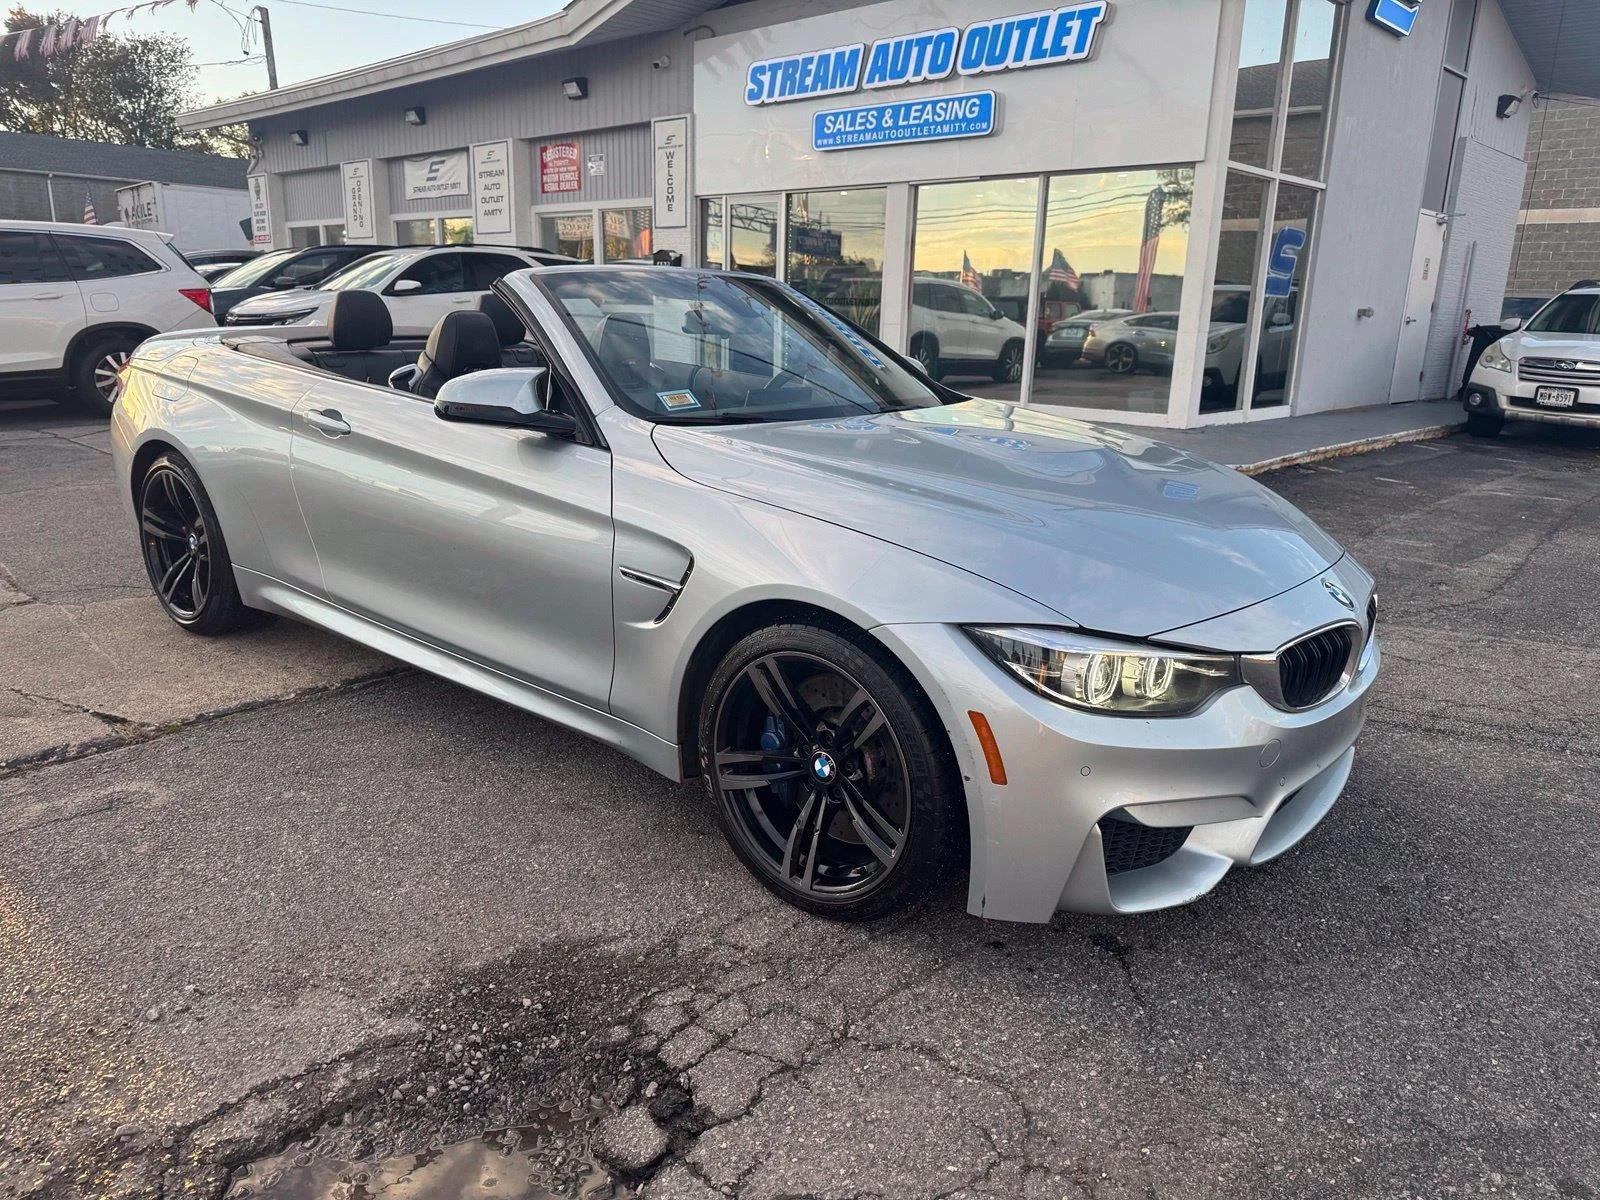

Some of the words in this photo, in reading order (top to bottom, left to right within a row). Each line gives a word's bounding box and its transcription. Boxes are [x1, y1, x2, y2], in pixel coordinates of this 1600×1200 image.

[747, 48, 861, 101] STREAM
[865, 31, 955, 86] AUTO
[960, 6, 1102, 70] OUTLET
[824, 110, 878, 134] SALES
[882, 108, 894, 127] &
[898, 98, 980, 126] LEASING
[478, 169, 505, 179] STREAM
[665, 151, 675, 212] WELCOME
[483, 183, 501, 191] AUTO
[480, 195, 504, 204] OUTLET
[483, 208, 503, 216] AMITY
